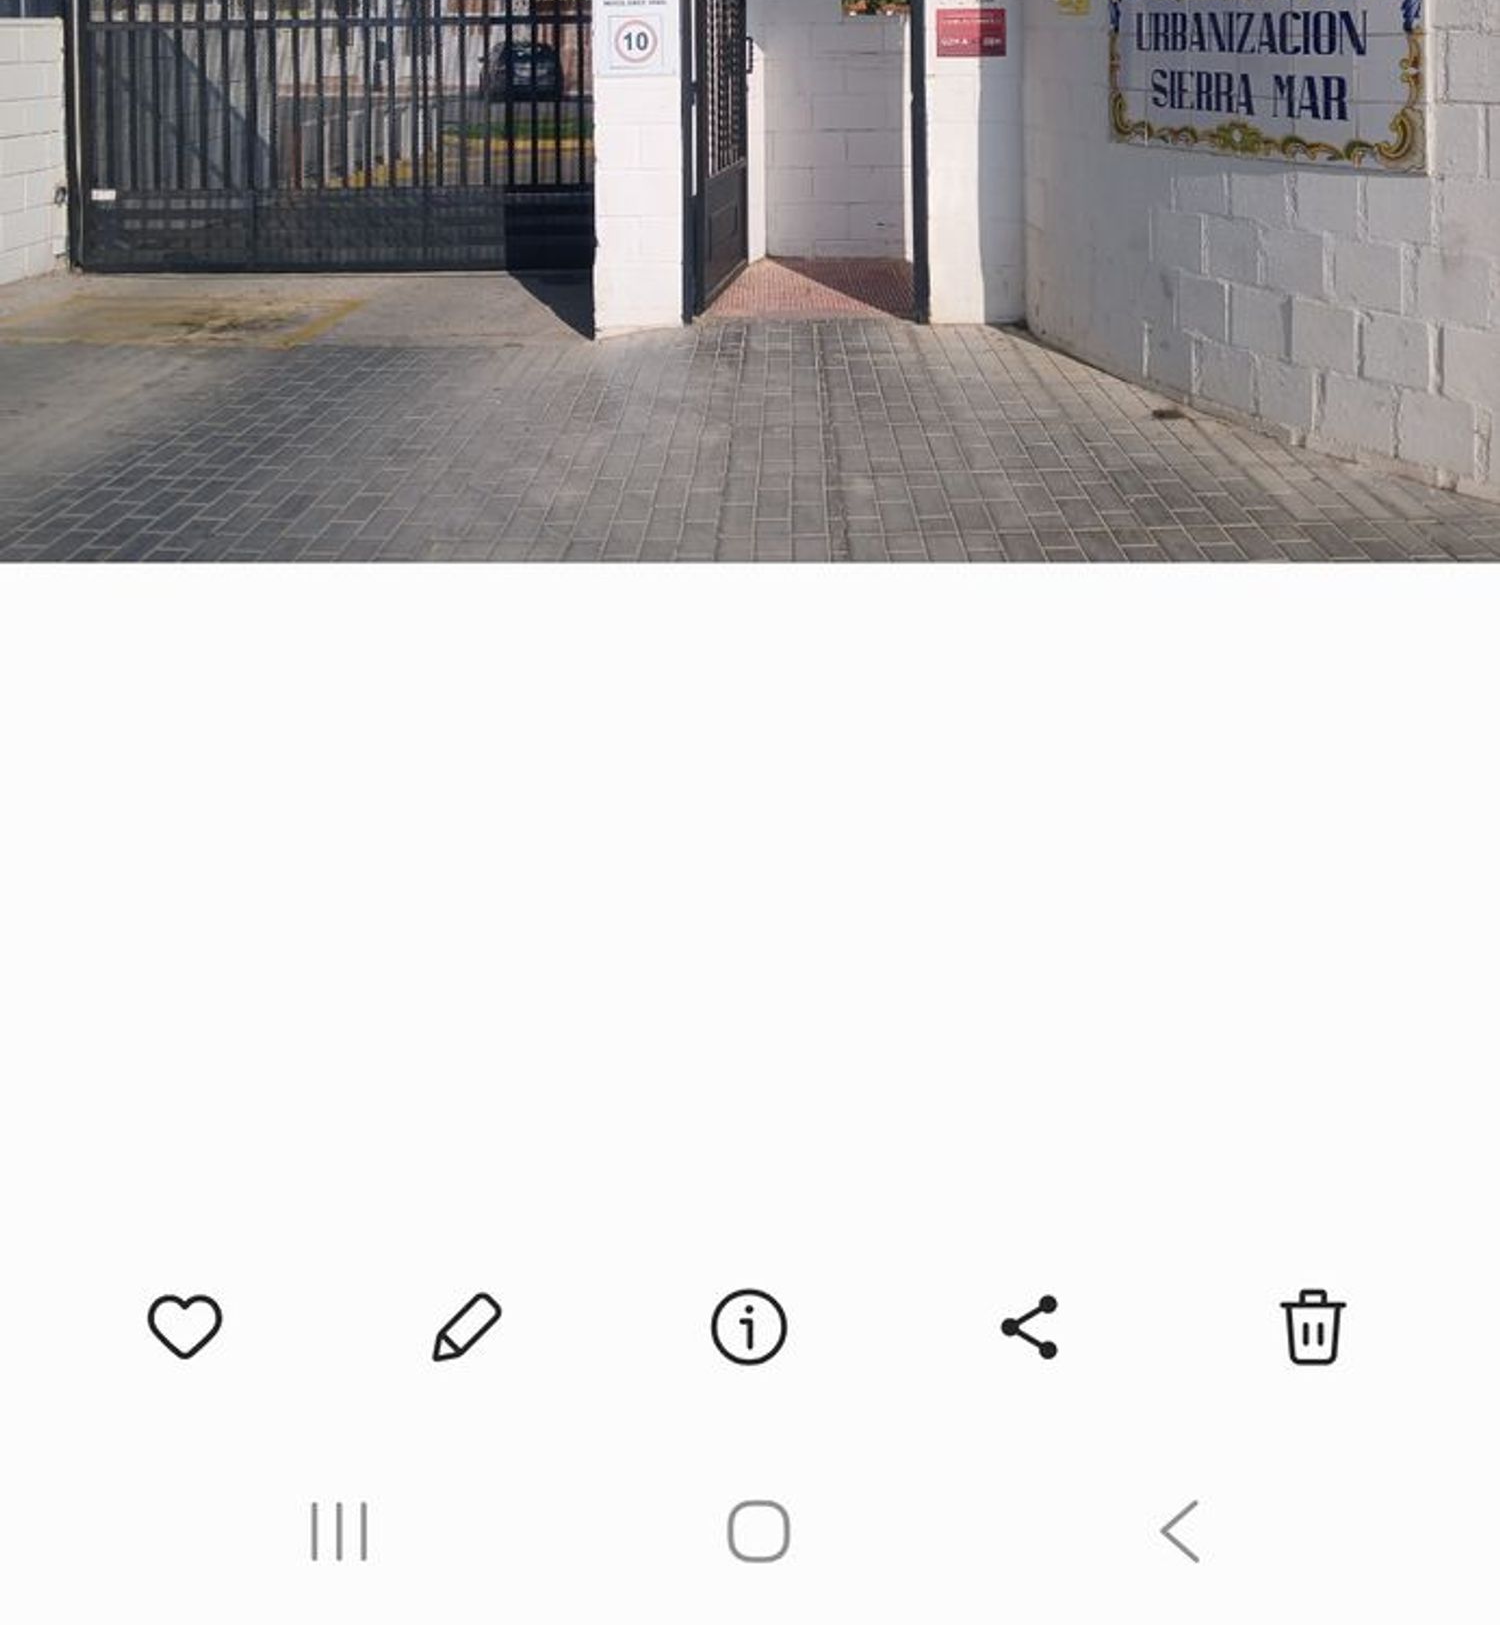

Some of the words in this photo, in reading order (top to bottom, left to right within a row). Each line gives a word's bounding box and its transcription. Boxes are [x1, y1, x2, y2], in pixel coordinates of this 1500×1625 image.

[623, 31, 649, 51] 10
[1135, 8, 1368, 56] URBANIZACION
[1151, 68, 1255, 116] SIERRA
[1272, 74, 1349, 121] MAR
